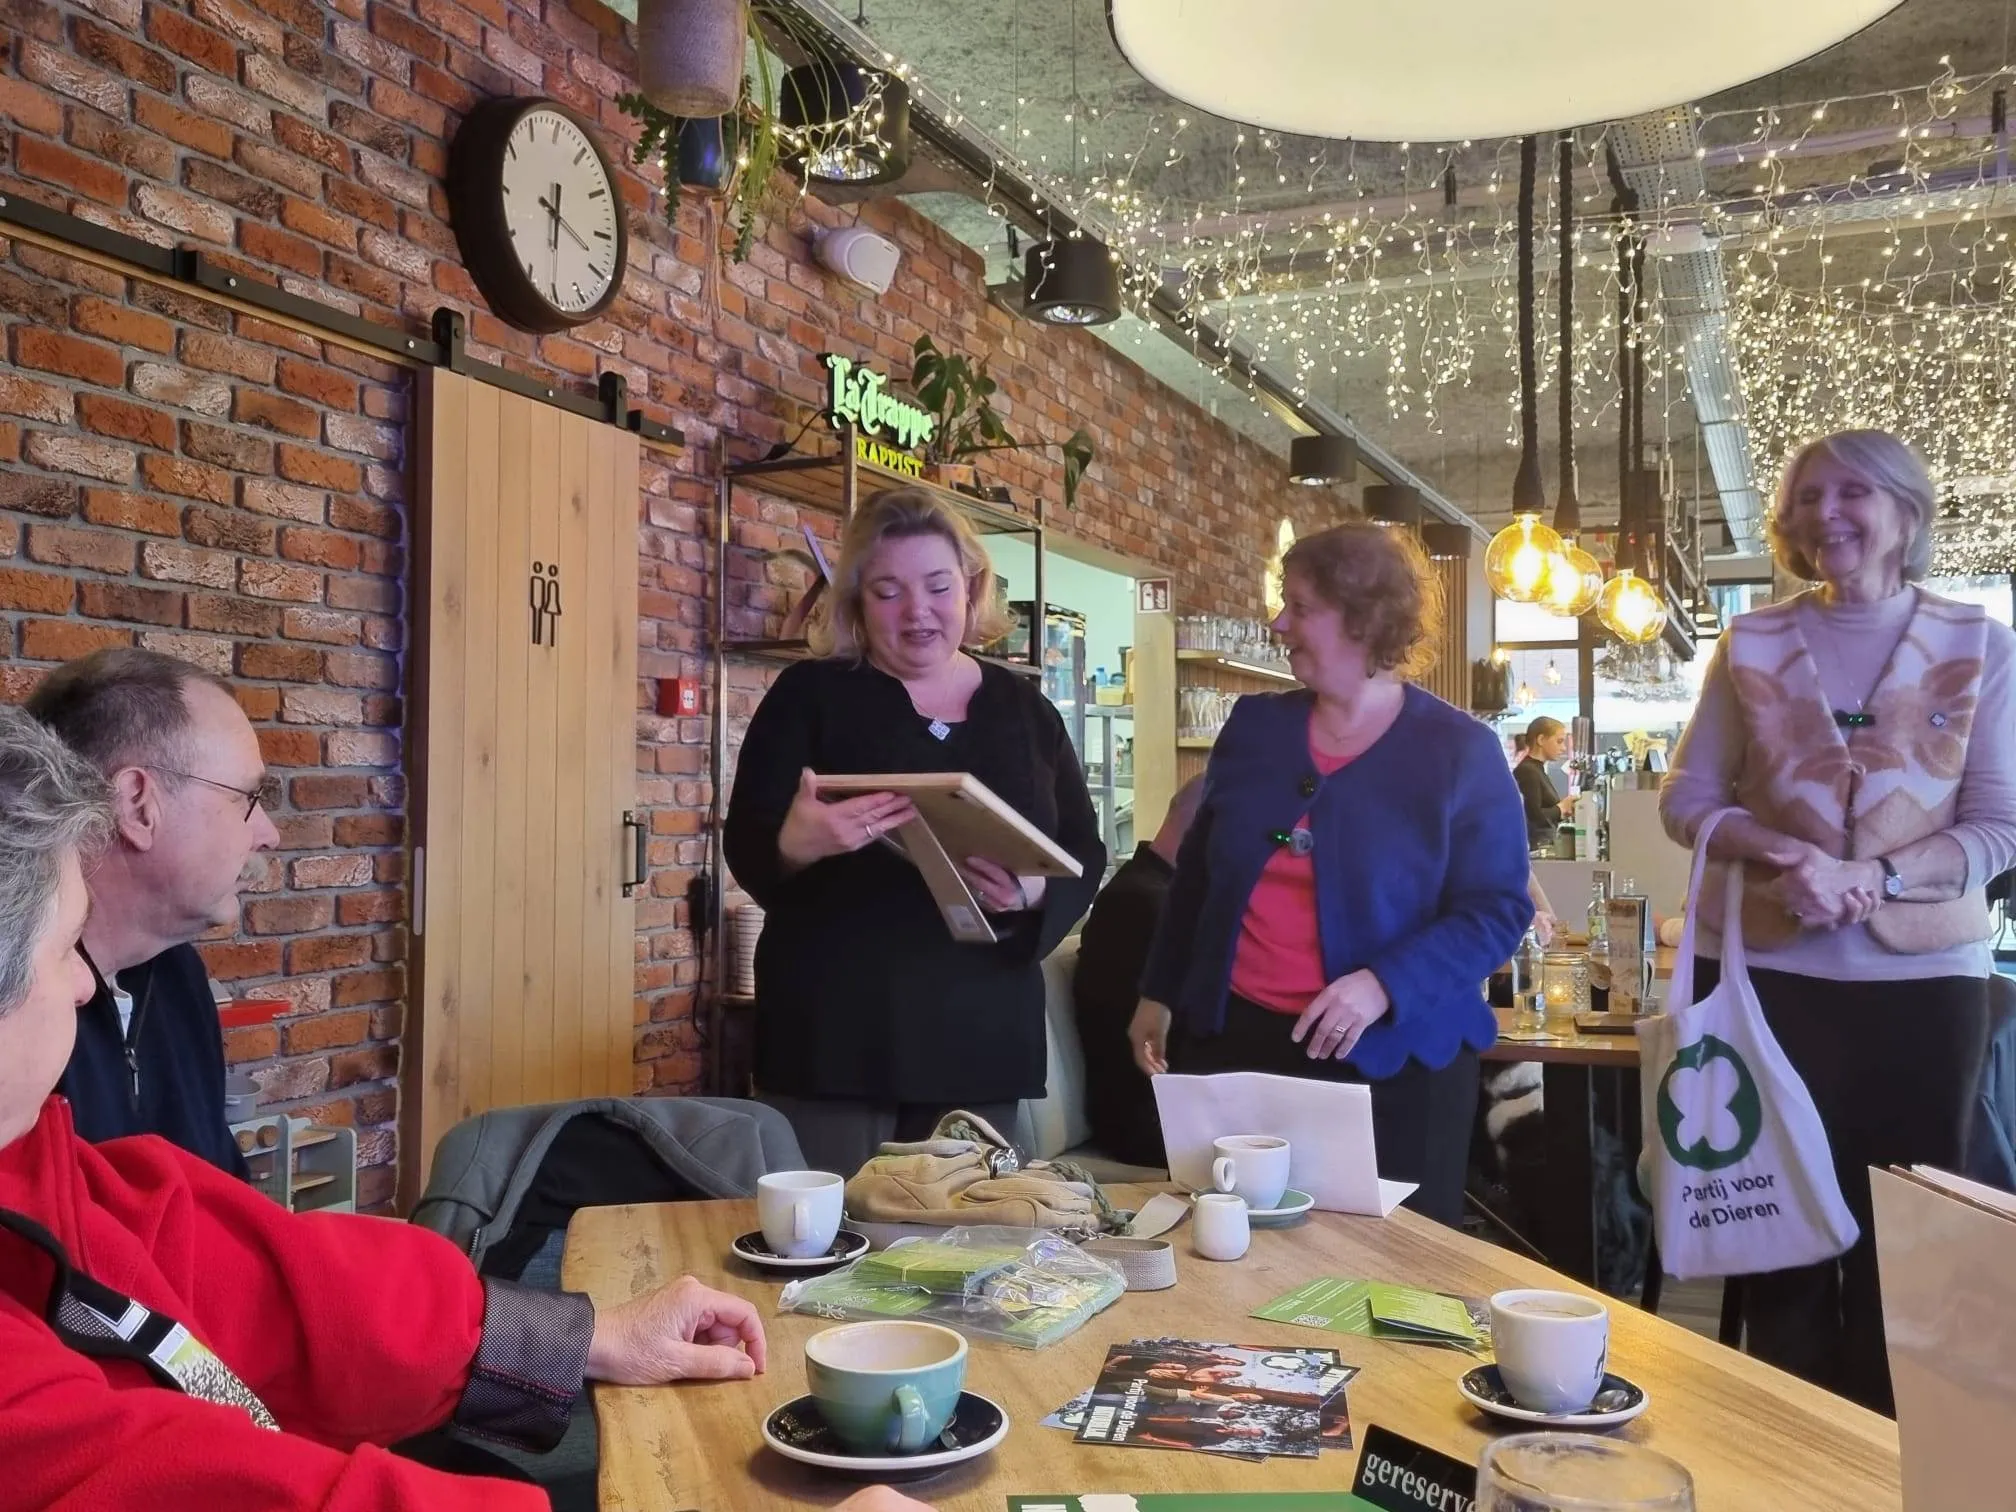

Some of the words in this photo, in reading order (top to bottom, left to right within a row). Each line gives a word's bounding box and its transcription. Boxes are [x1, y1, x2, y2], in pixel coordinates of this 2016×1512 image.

[856, 437, 924, 477] RAPPIST
[1682, 1179, 1729, 1202] Partij
[1730, 1174, 1774, 1192] voor
[1689, 1210, 1710, 1229] de
[1711, 1202, 1780, 1225] Dieren
[1125, 1378, 1149, 1396] Partij
[1120, 1410, 1138, 1420] de
[1112, 1420, 1136, 1441] Dieren
